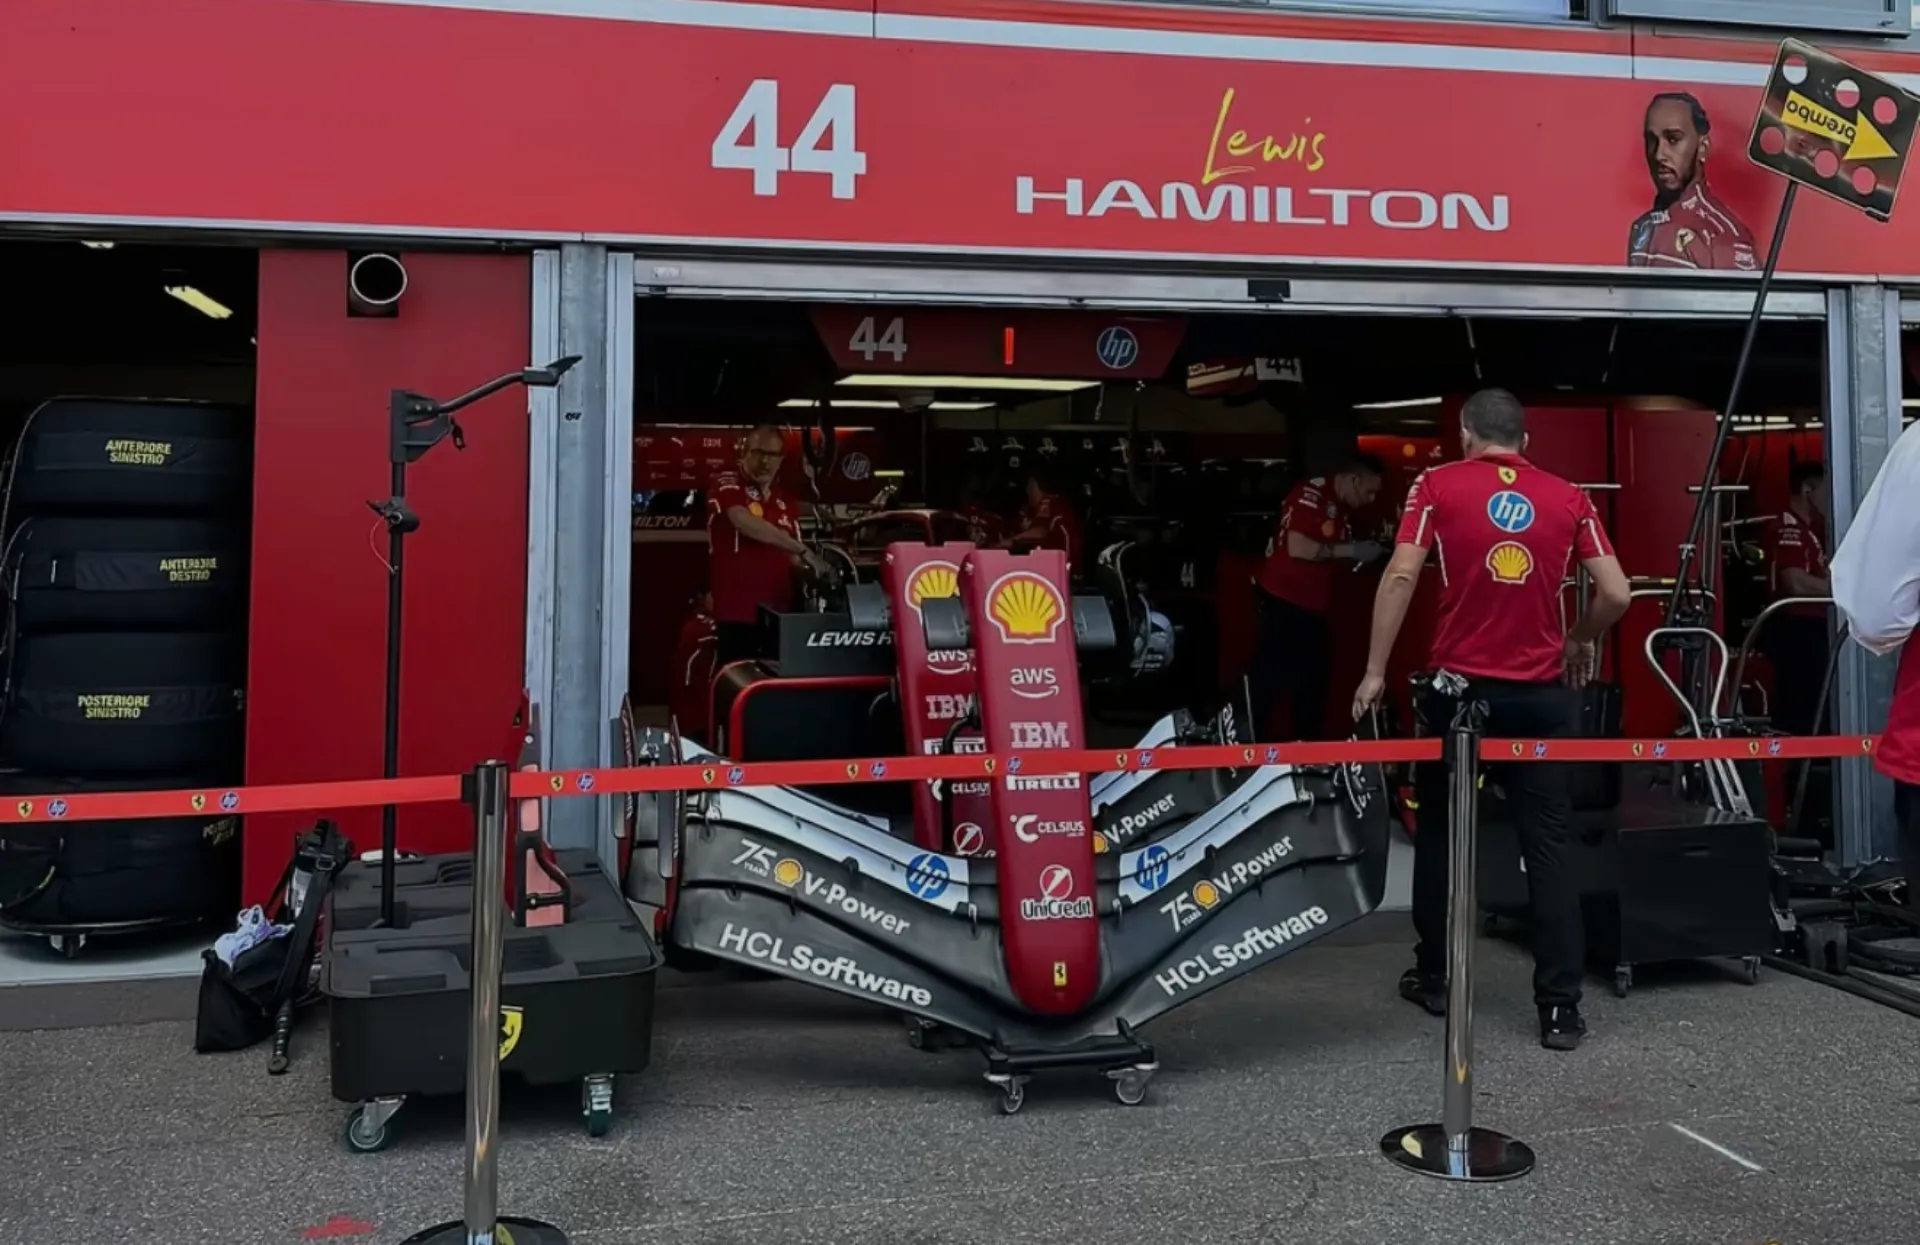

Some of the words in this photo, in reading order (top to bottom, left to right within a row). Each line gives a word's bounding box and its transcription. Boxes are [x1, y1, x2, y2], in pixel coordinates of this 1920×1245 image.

[712, 78, 867, 199] 44
[1202, 87, 1326, 185] Lewis
[1787, 100, 1856, 143] brembo
[1016, 175, 1509, 231] HAMILTON
[849, 316, 908, 361] 44
[1100, 327, 1135, 368] hp
[105, 440, 172, 455] ANTERIORE
[110, 453, 164, 465] SINISTRO
[1491, 490, 1532, 532] hp
[806, 631, 877, 647] LEWIS
[1010, 668, 1056, 685] aws
[78, 695, 150, 708] POSTERIORE
[85, 707, 141, 719] SINISTRO
[1010, 722, 1070, 749] IBM
[1006, 773, 1080, 790] PIRELLI
[1038, 821, 1085, 832] CELSIUS
[1105, 793, 1176, 844] V-Power
[732, 839, 777, 871] 75
[1137, 846, 1168, 890] hp
[1214, 836, 1295, 895] V-Power
[907, 854, 948, 899] hp
[803, 872, 911, 935] V-Power
[1021, 896, 1093, 920] UniCredit
[1160, 892, 1196, 933] 75
[719, 922, 933, 1006] HCLSoftware
[1155, 905, 1329, 996] HCLSoftware
